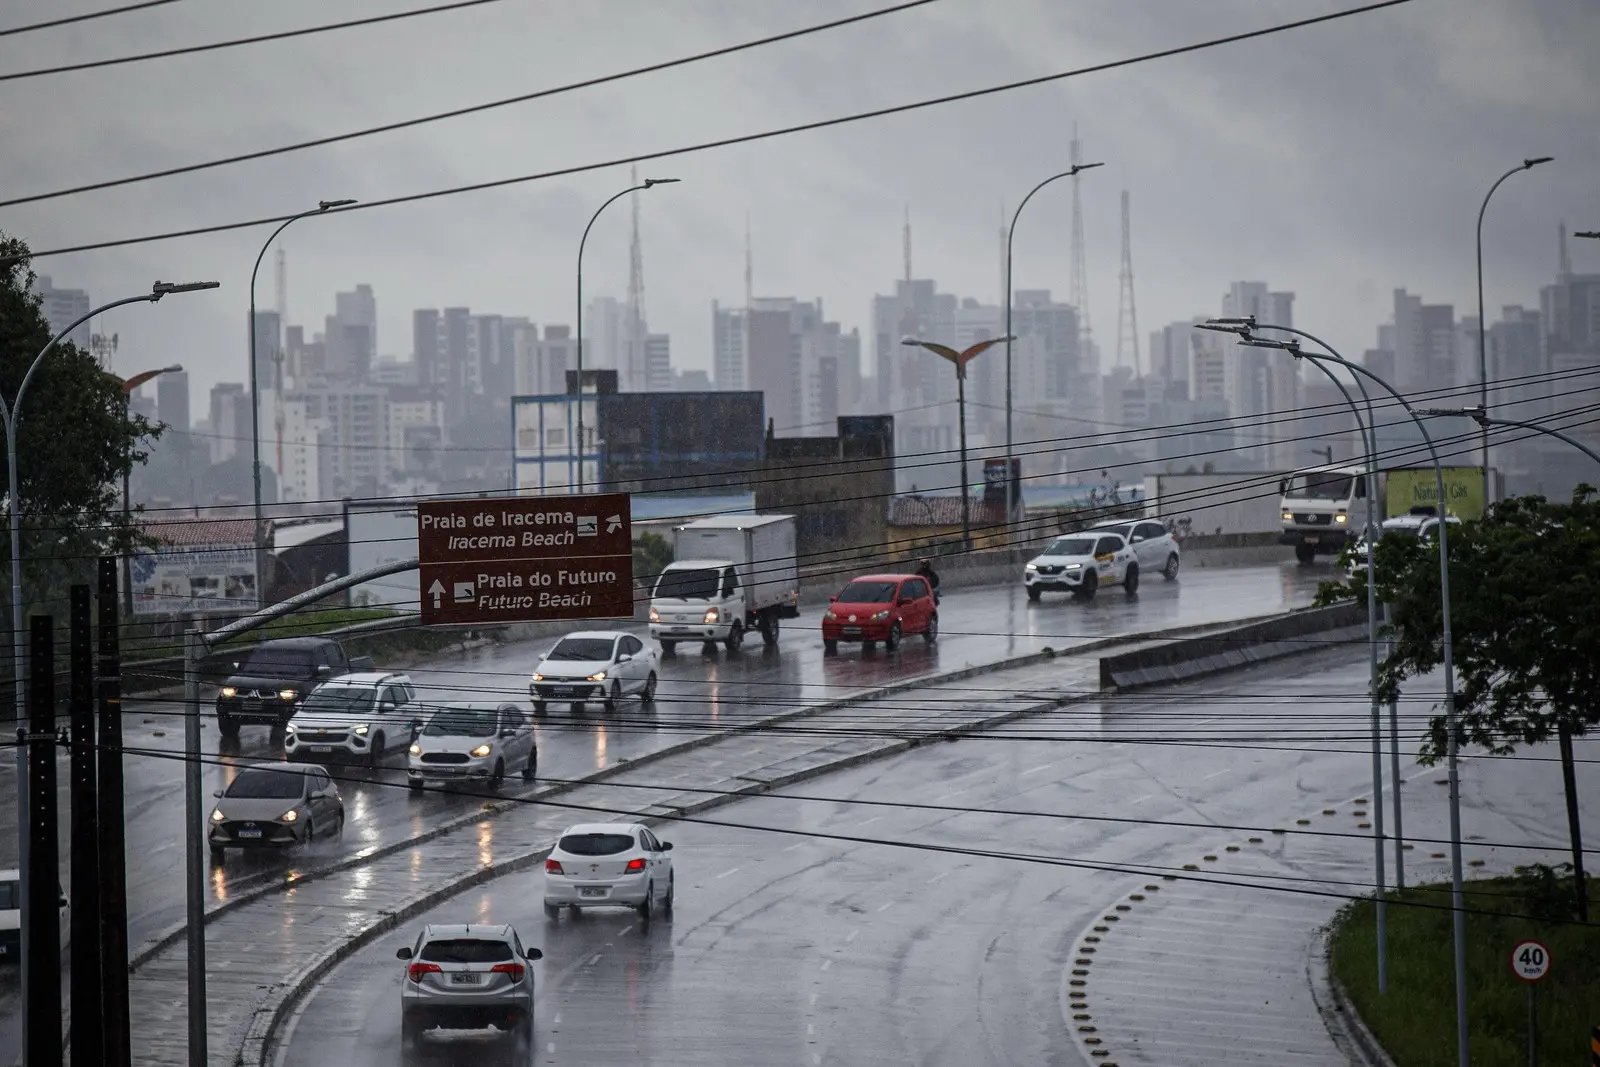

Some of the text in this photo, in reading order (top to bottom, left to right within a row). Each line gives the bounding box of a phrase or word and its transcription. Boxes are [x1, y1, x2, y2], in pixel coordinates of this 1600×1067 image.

[1414, 484, 1447, 500] Natul
[421, 511, 574, 529] Praia de Iracema
[448, 530, 574, 550] Iracema Beach
[477, 570, 616, 588] Praia do Futuro
[479, 591, 591, 610] Futuro Beach
[1519, 948, 1543, 965] 40
